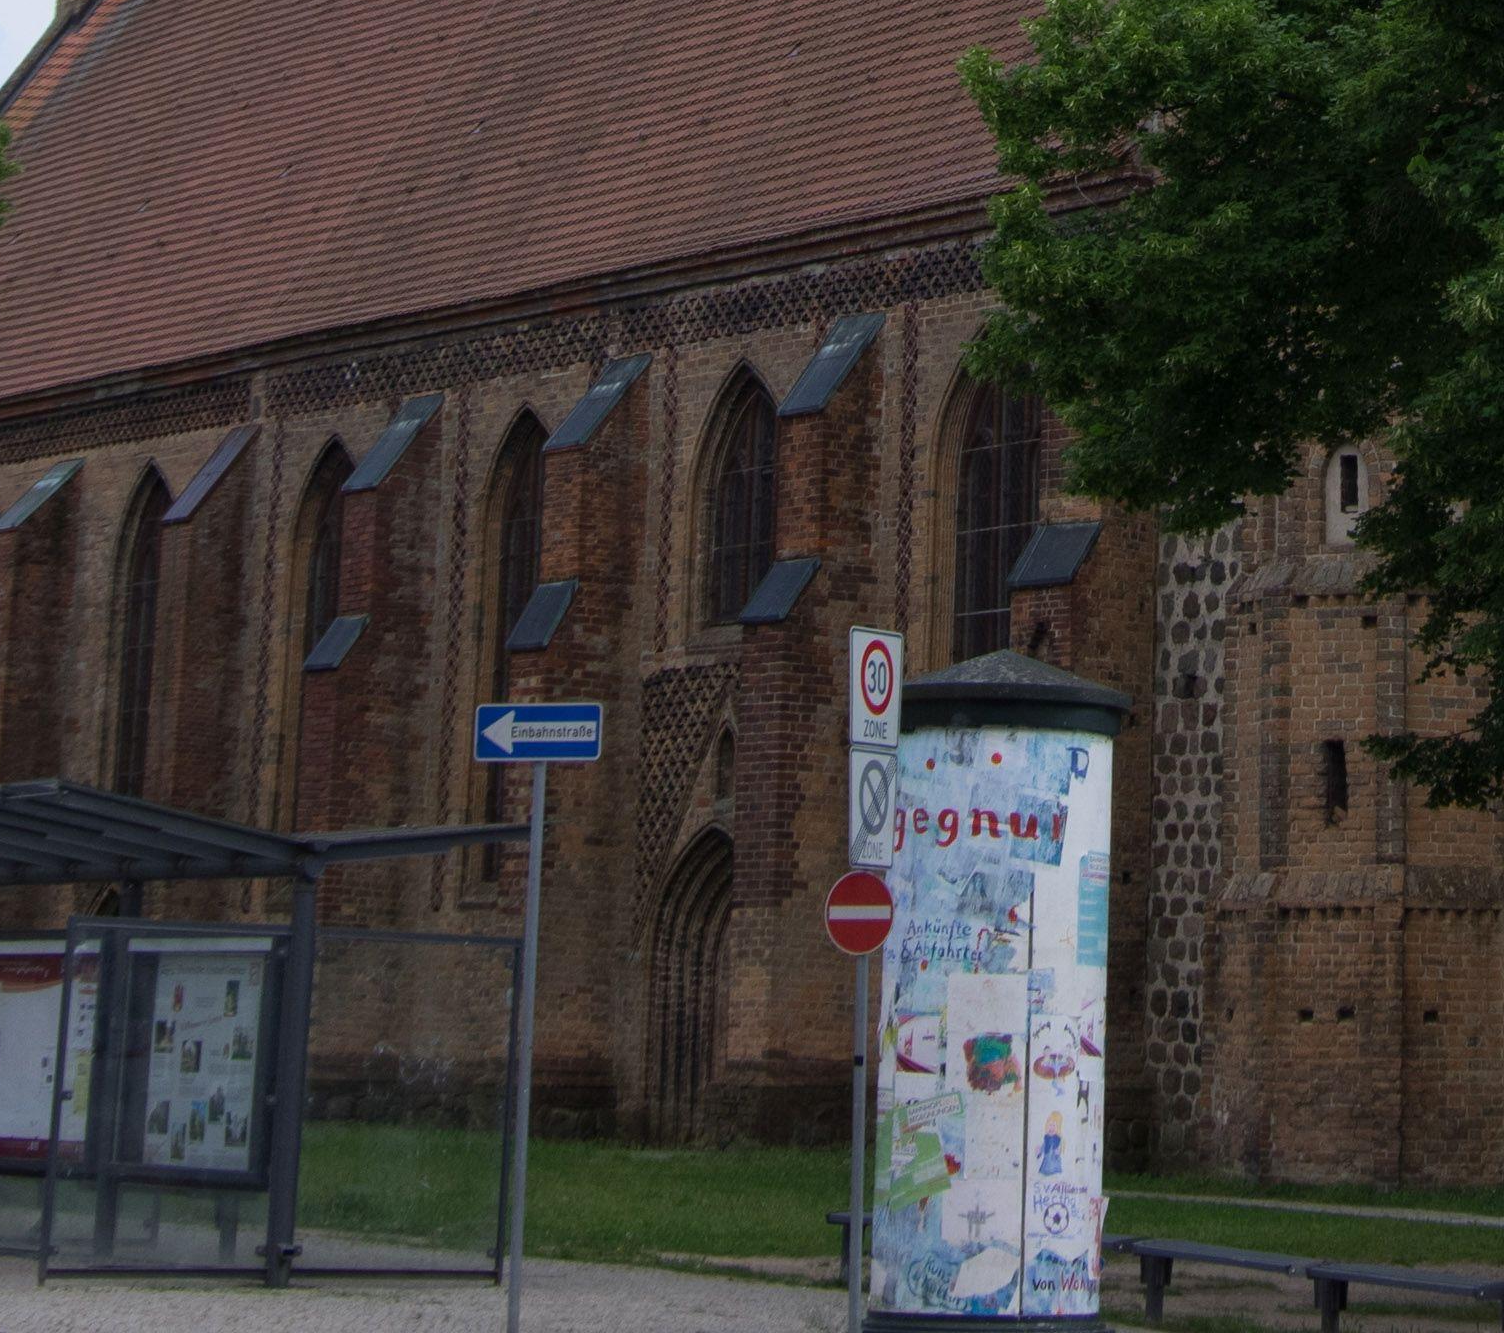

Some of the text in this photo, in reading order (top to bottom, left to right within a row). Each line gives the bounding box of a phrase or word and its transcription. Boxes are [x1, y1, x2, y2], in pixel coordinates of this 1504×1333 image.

[867, 660, 887, 695] 30
[511, 724, 593, 739] Einbahnstraße
[863, 720, 888, 739] ZONE
[861, 841, 884, 860] ZONE
[906, 918, 972, 940] Ankünfte
